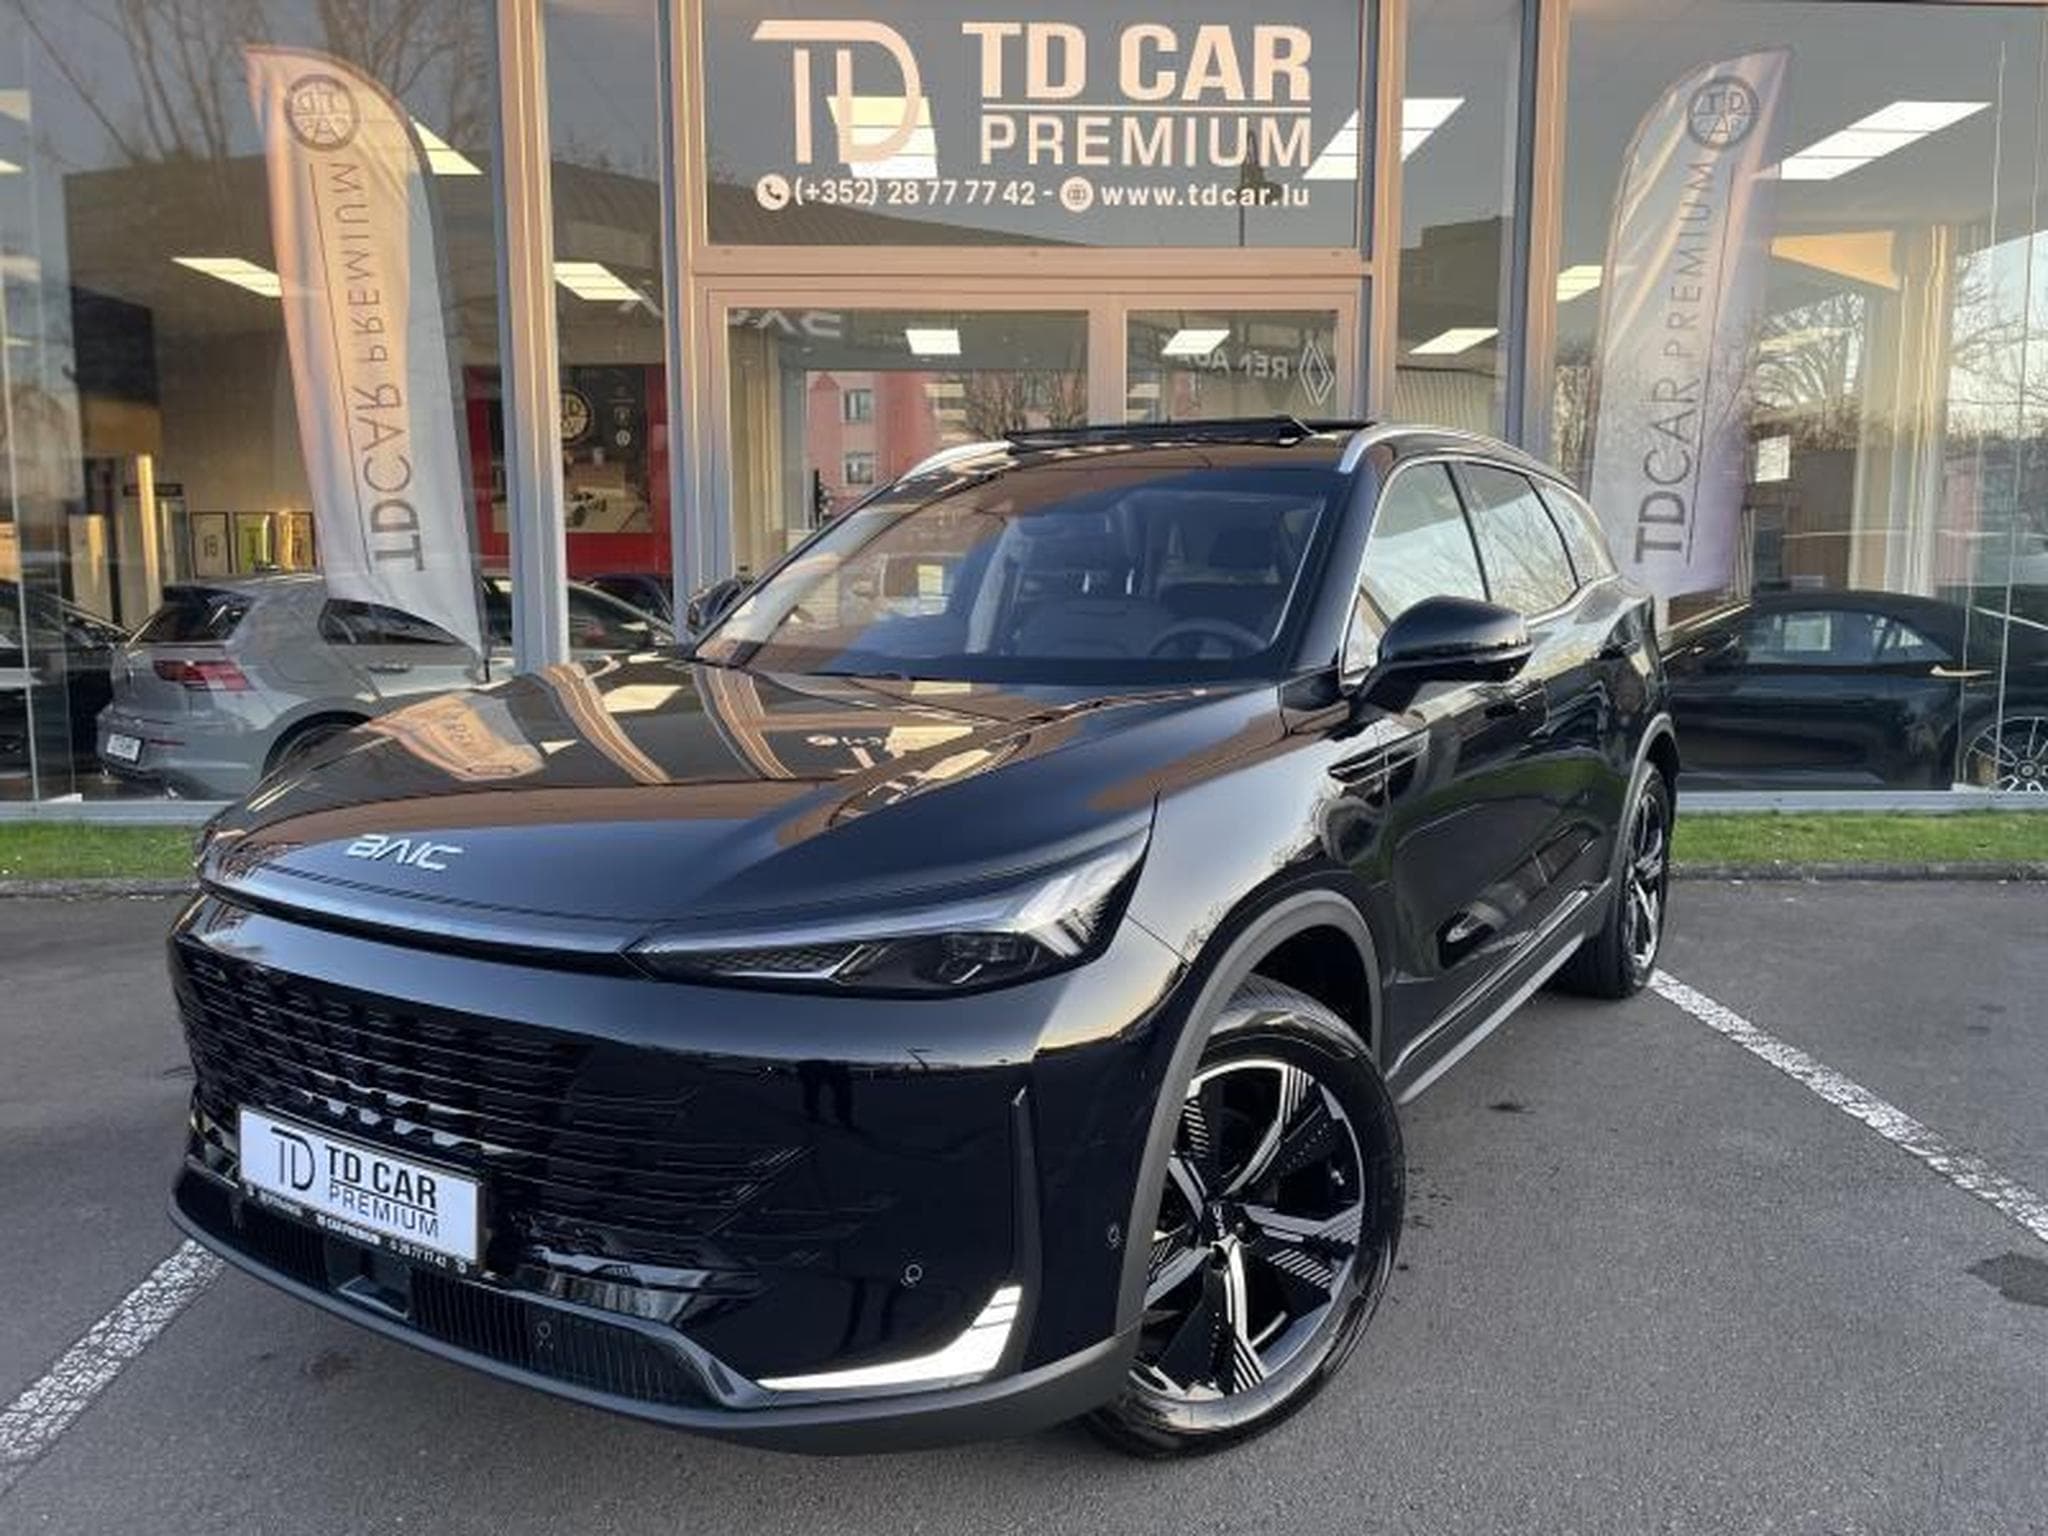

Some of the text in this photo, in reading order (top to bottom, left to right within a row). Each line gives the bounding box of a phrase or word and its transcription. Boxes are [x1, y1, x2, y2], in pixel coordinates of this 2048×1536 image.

[962, 22, 1312, 102] TD CAR
[980, 114, 1312, 168] PREMIUM
[794, 177, 879, 206] (+352)
[887, 181, 920, 205] 28
[926, 180, 958, 205] 77
[965, 180, 997, 205] 77
[1003, 180, 1035, 206] 42
[1100, 182, 1311, 206] www.tdcar.lu
[1633, 161, 1716, 565] TDCAR PREMIUM
[346, 833, 464, 872] BAIC
[325, 1143, 437, 1210] TD CAR
[329, 1183, 439, 1240] PREMIUM
